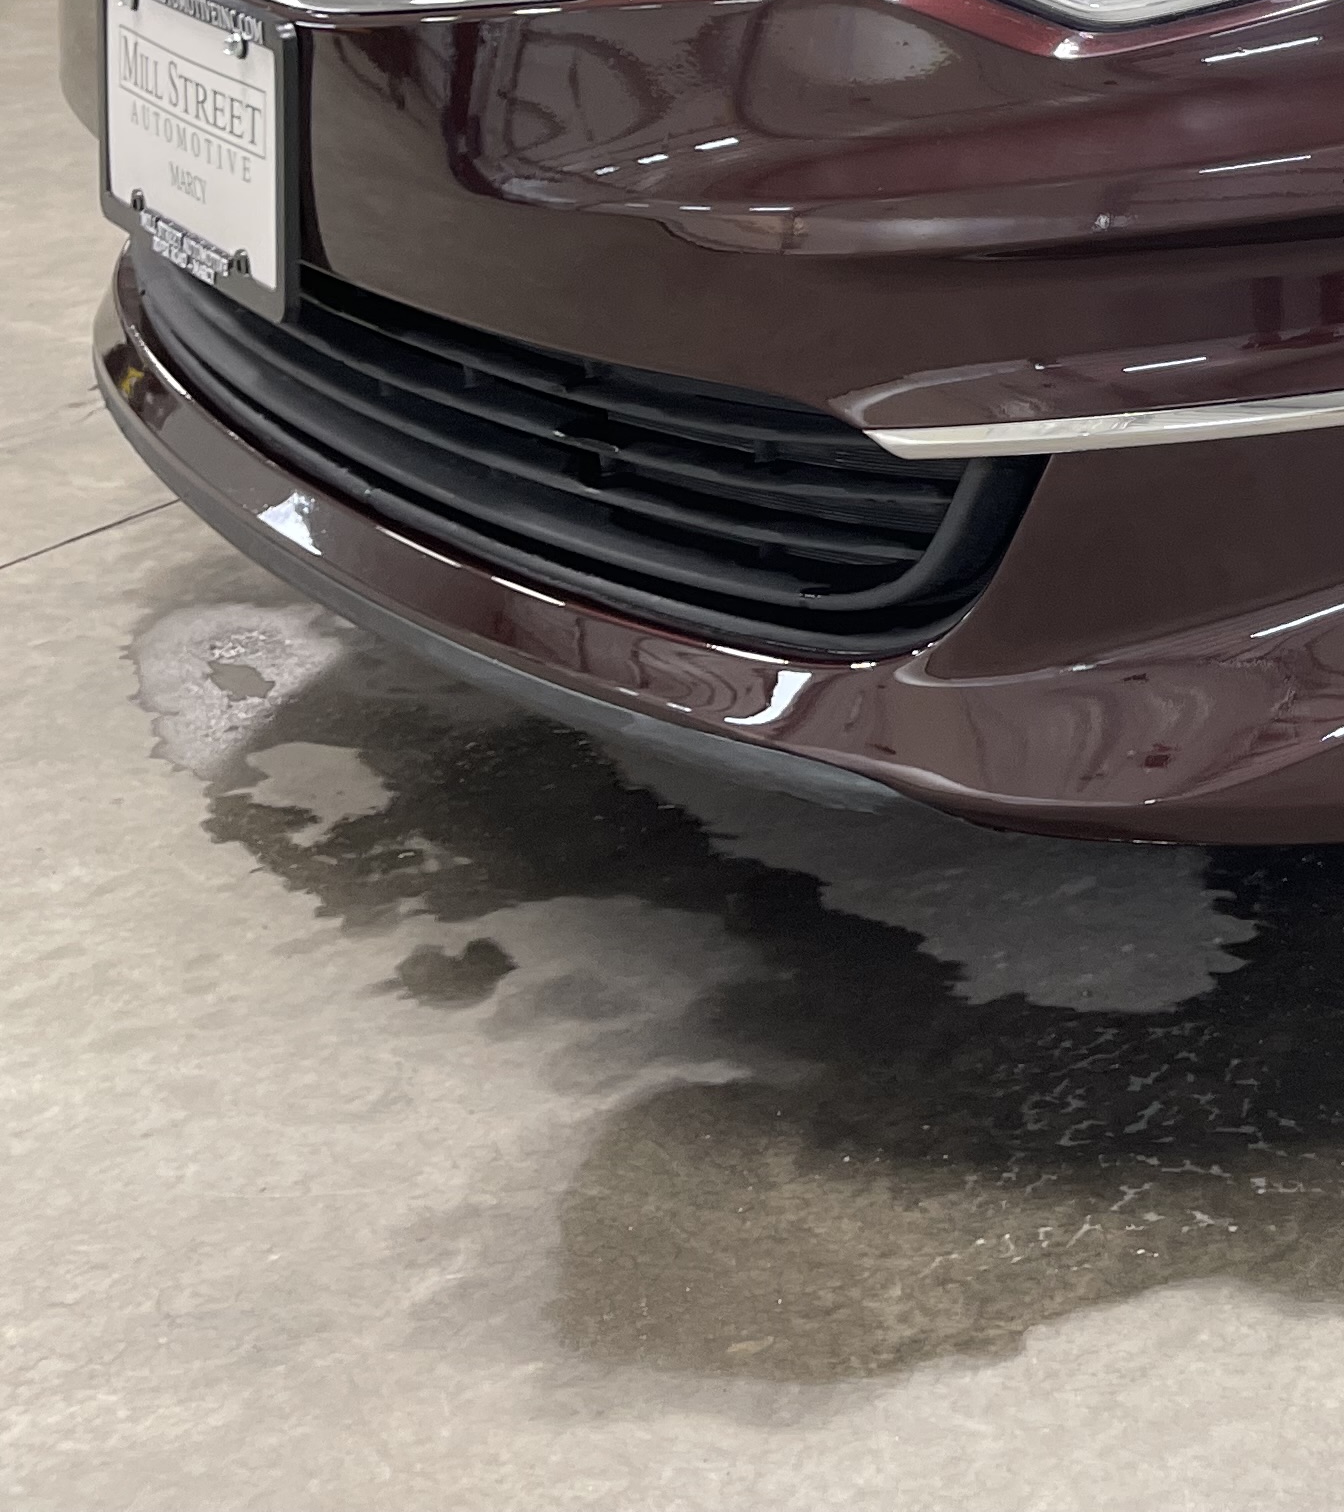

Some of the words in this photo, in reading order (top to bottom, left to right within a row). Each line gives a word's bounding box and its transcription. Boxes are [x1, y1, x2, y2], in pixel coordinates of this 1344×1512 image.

[131, 99, 252, 183] AUTOMOTIVE
[168, 60, 262, 146] STREET
[169, 161, 207, 205] MARCY
